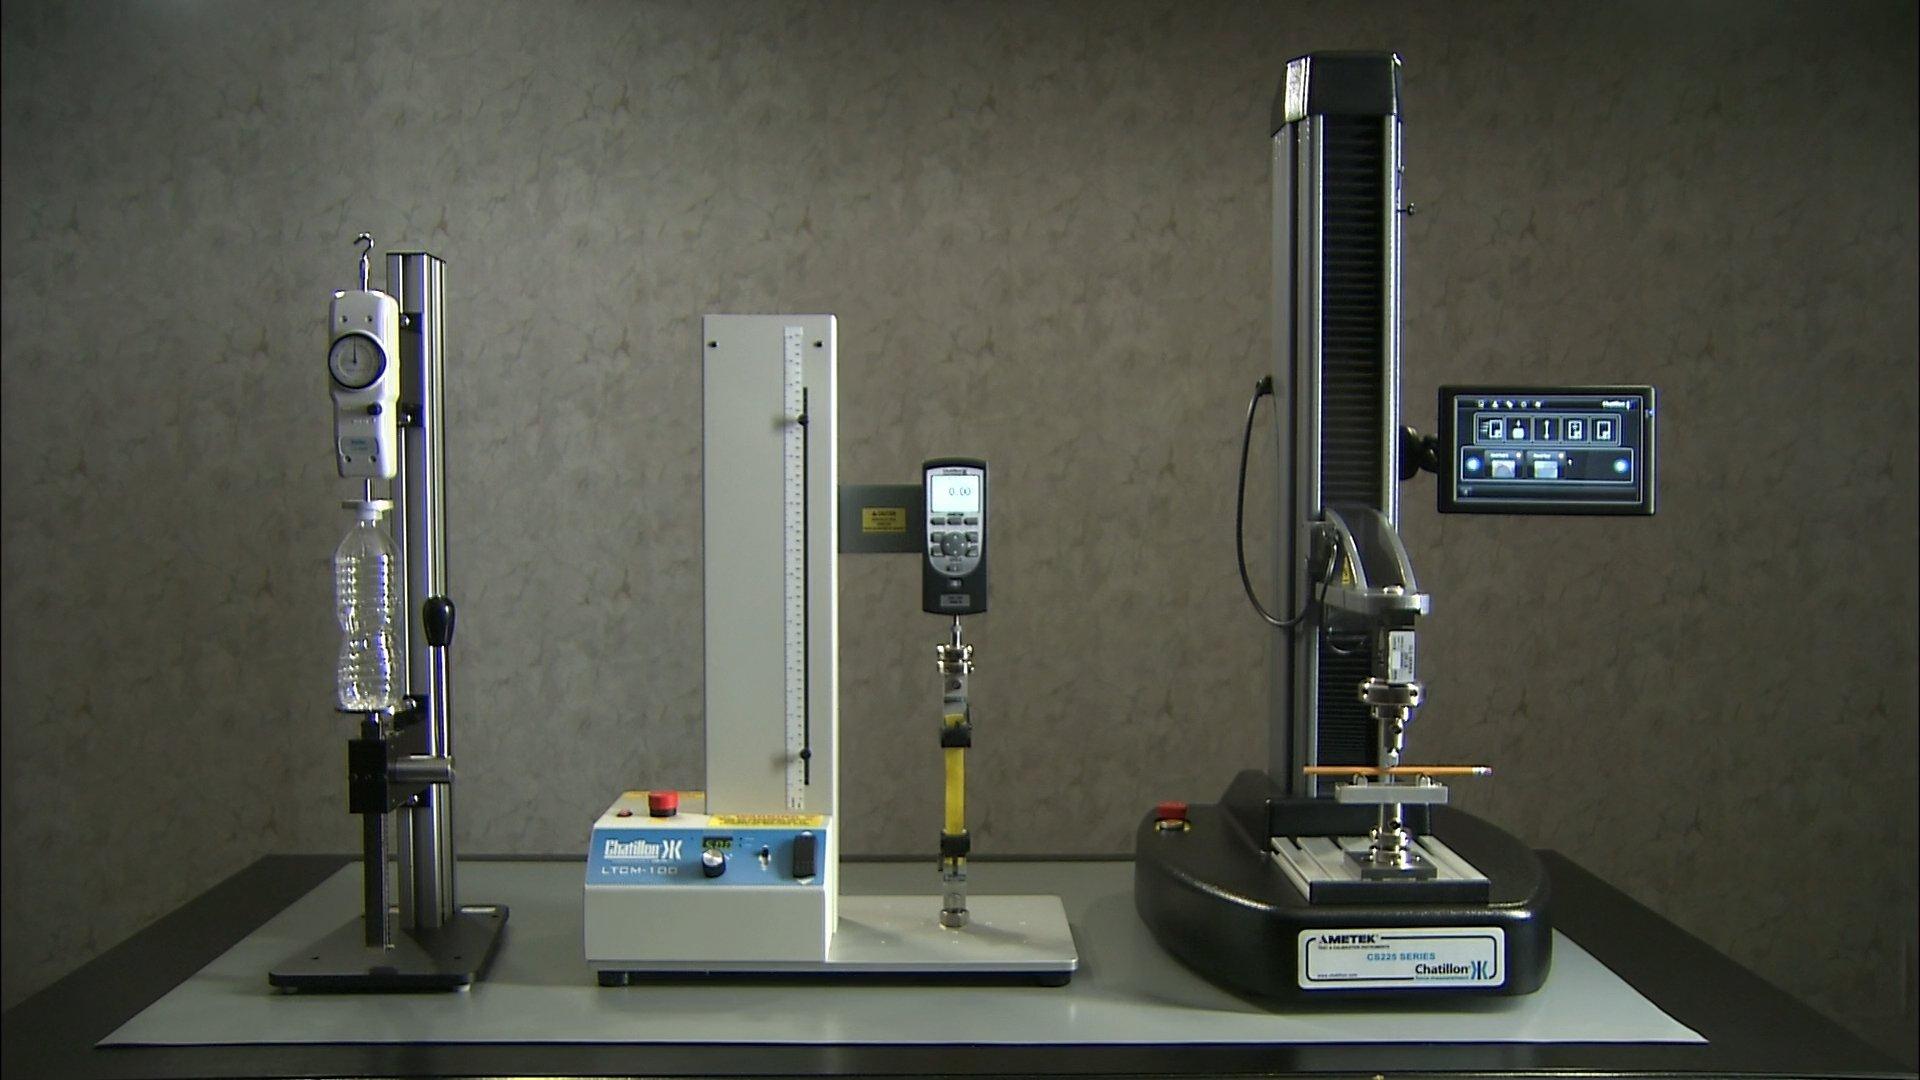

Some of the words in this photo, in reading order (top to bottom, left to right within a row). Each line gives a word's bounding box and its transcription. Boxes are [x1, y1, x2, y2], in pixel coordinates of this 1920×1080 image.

[604, 839, 660, 859] Chatillon
[601, 866, 678, 874] LTCM-100
[1319, 934, 1376, 944] AMETEK
[1400, 952, 1436, 960] SERIES
[1415, 963, 1469, 974] Chatillon
